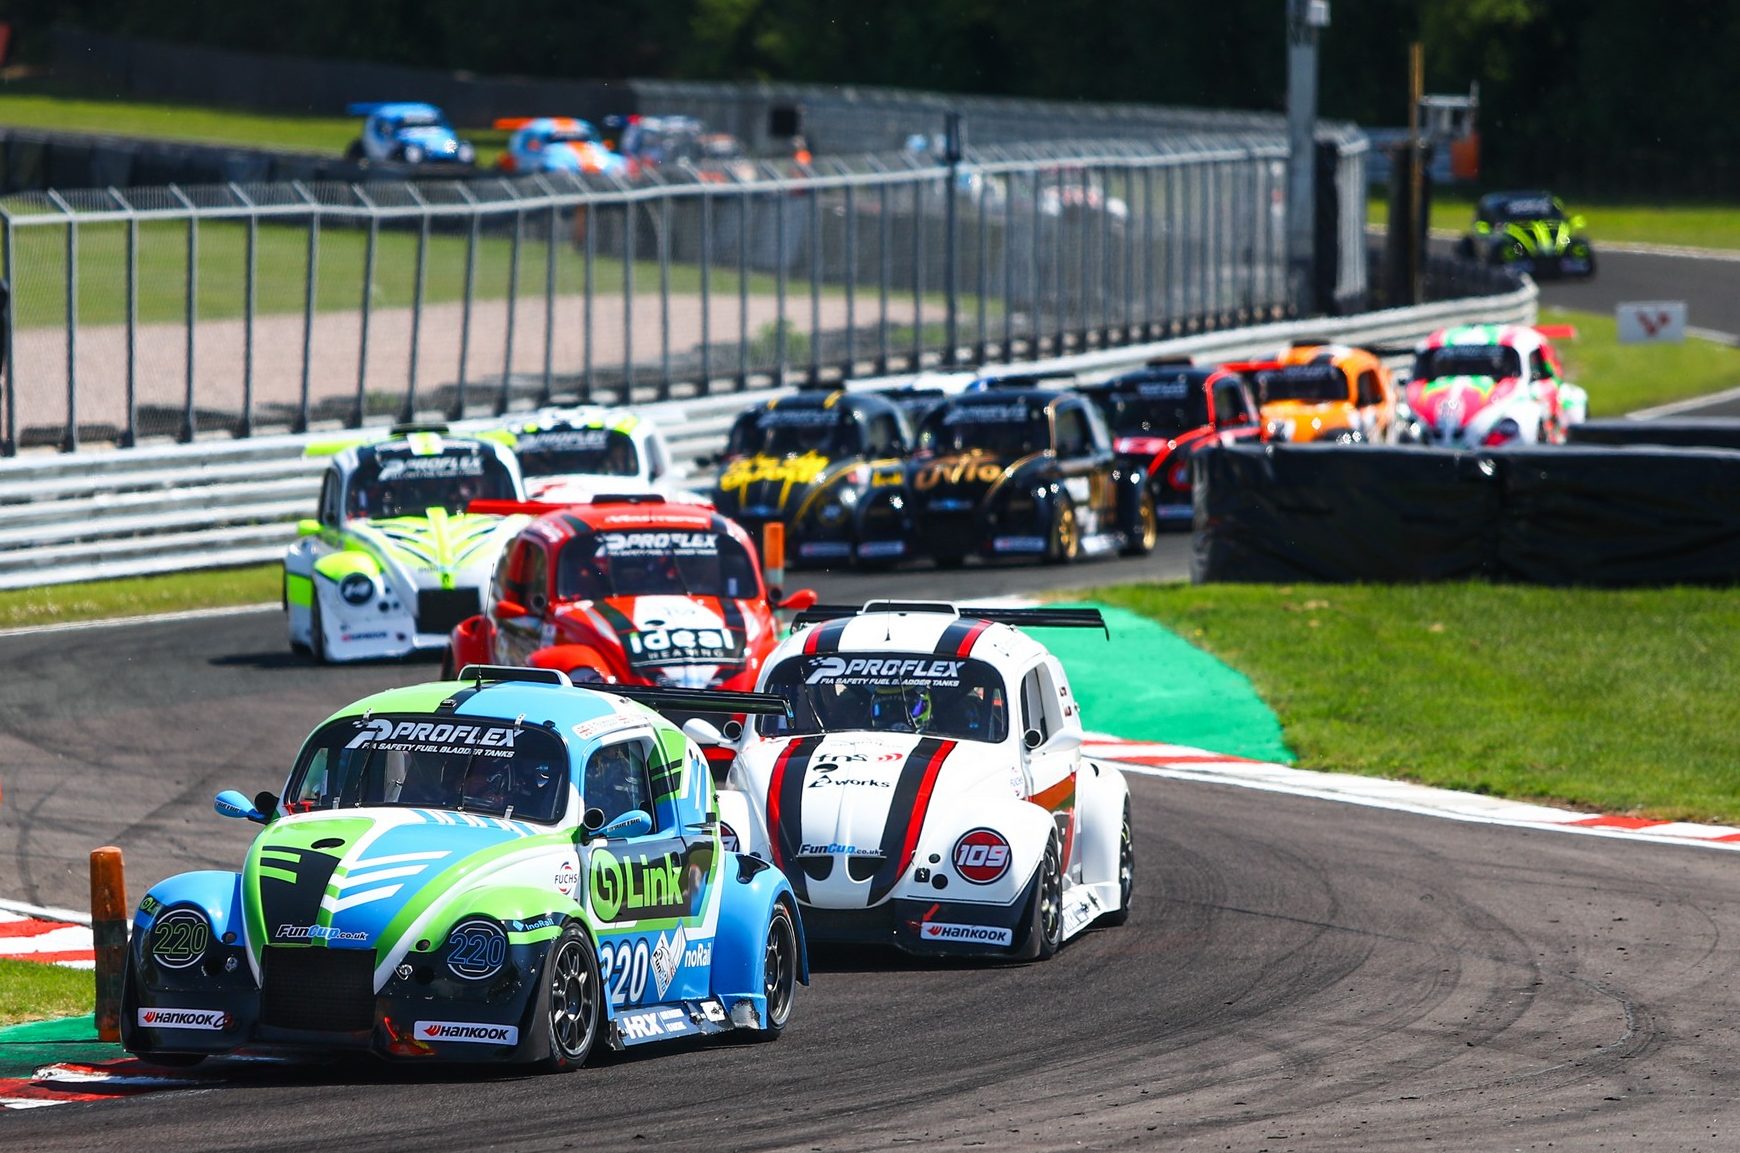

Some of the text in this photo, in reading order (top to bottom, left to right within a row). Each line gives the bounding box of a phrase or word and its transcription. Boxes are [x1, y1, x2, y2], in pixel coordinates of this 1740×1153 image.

[625, 533, 718, 548] PROFLEX
[629, 628, 735, 654] ideal
[844, 659, 966, 678] PROFLEX
[834, 677, 869, 685] SAFETY
[932, 679, 960, 687] TANKS
[389, 721, 525, 748] PROFLEX
[361, 742, 377, 750] FA
[377, 743, 415, 751] SAFETY
[414, 744, 438, 753] FUEL
[484, 749, 515, 758] TANKS
[957, 844, 1009, 867] 109
[554, 874, 578, 885] FUCHS
[623, 852, 684, 909] Link
[153, 922, 209, 954] 220
[447, 933, 506, 967] 220
[623, 1012, 665, 1040] HRX
